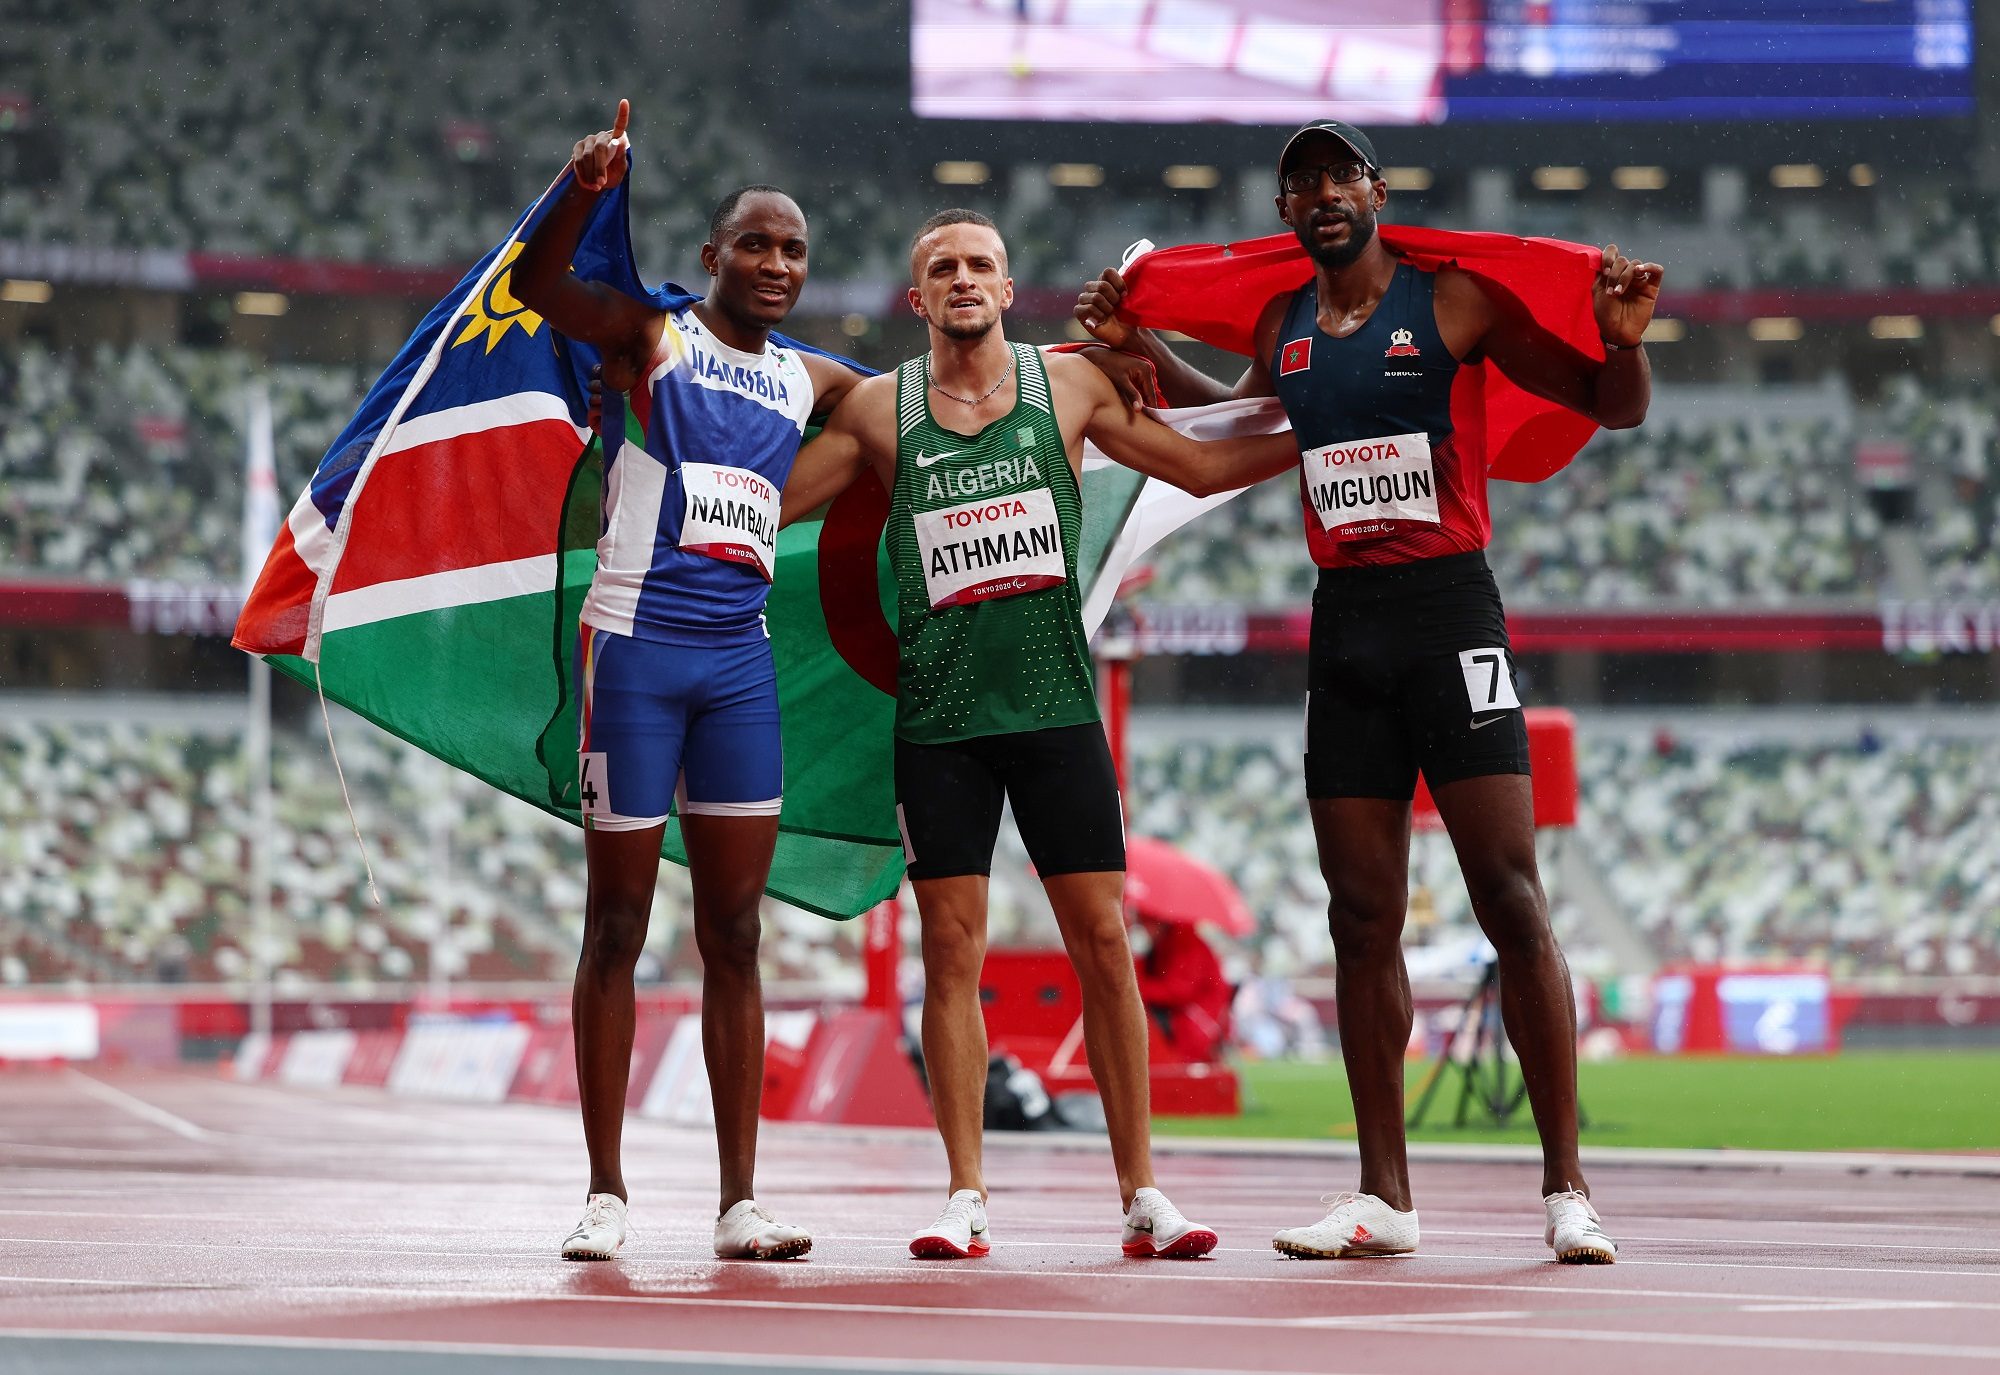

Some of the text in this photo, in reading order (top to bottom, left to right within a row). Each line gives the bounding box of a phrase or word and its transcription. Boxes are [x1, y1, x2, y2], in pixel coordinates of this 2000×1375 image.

[1322, 443, 1400, 467] TOYOTA
[712, 470, 771, 504] TOYOTA
[926, 455, 1041, 500] ALGERIA
[1313, 469, 1432, 514] AMGUOUN
[691, 494, 775, 553] NAMBALA
[943, 500, 1028, 530] TOYOTA
[1340, 524, 1379, 536] TOKYO 2020
[724, 547, 746, 558] TOKYO
[930, 523, 1058, 578] ATHMANI
[972, 582, 1012, 596] TOKYO 2020
[1471, 653, 1500, 704] 7
[581, 759, 598, 808] 4
